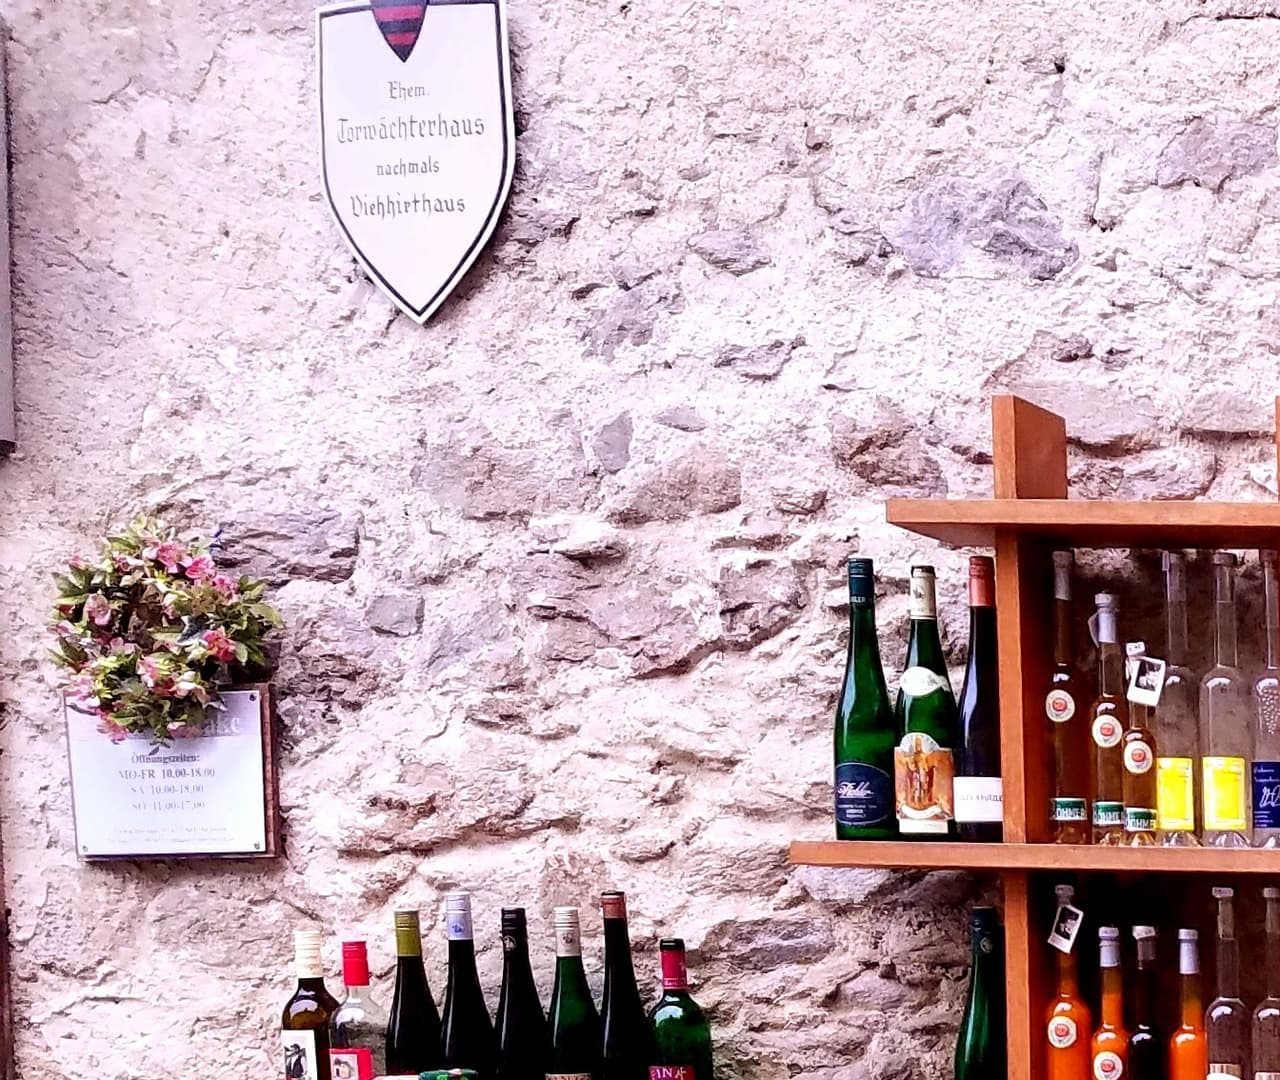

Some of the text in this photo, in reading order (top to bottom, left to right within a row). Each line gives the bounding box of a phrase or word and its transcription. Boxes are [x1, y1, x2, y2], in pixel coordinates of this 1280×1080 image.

[387, 80, 430, 101] Ehem.
[337, 112, 485, 143] Torwächterhaus
[375, 155, 440, 177] nachmals
[349, 191, 466, 220] Viehhirthaus
